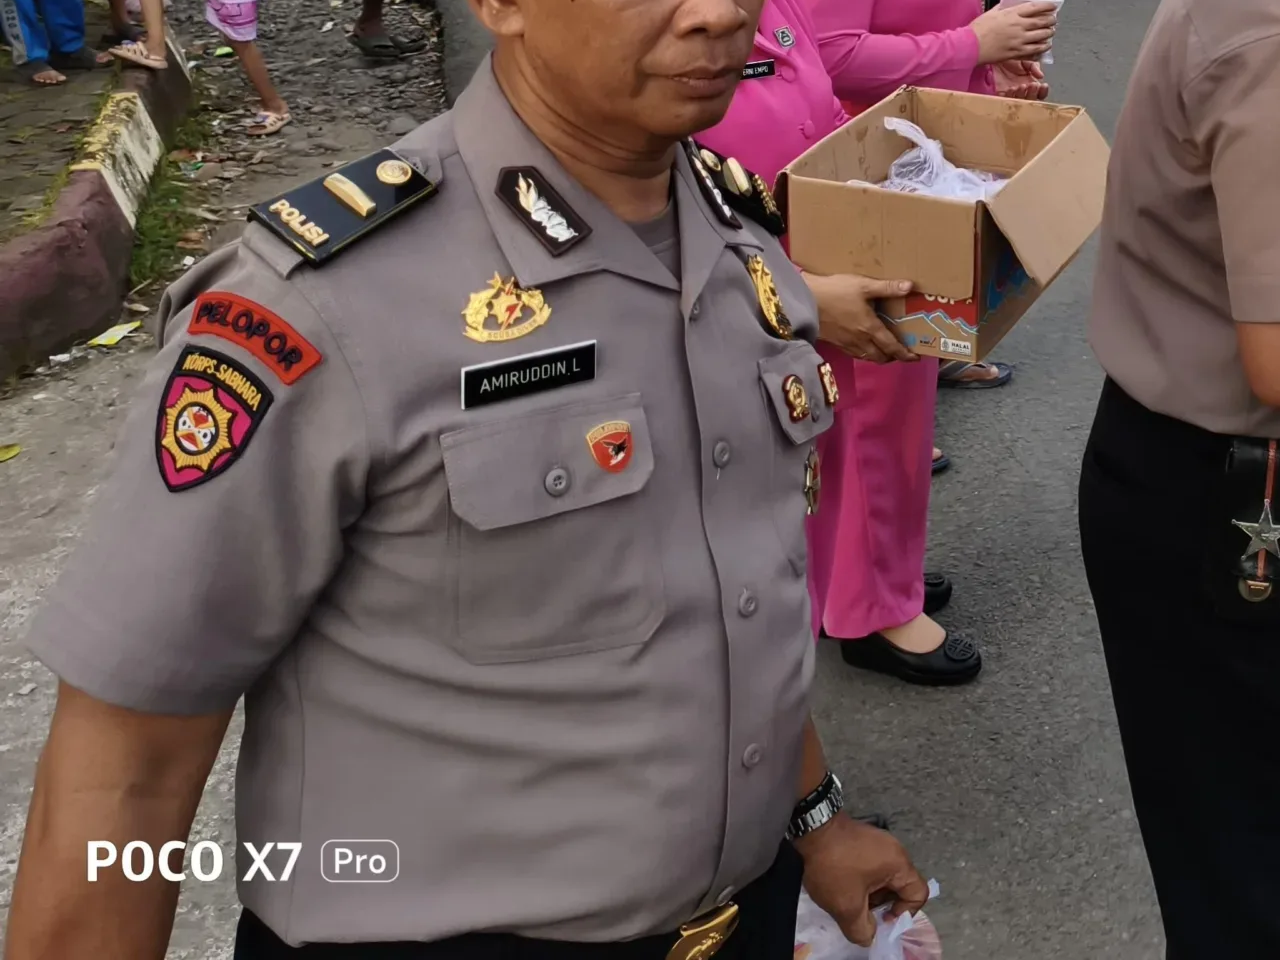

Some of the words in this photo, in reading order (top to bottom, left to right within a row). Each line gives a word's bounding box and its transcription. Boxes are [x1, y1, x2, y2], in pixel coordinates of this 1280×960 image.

[269, 199, 330, 247] POLISI
[195, 300, 304, 372] PELOPOR
[951, 342, 970, 350] HALAL
